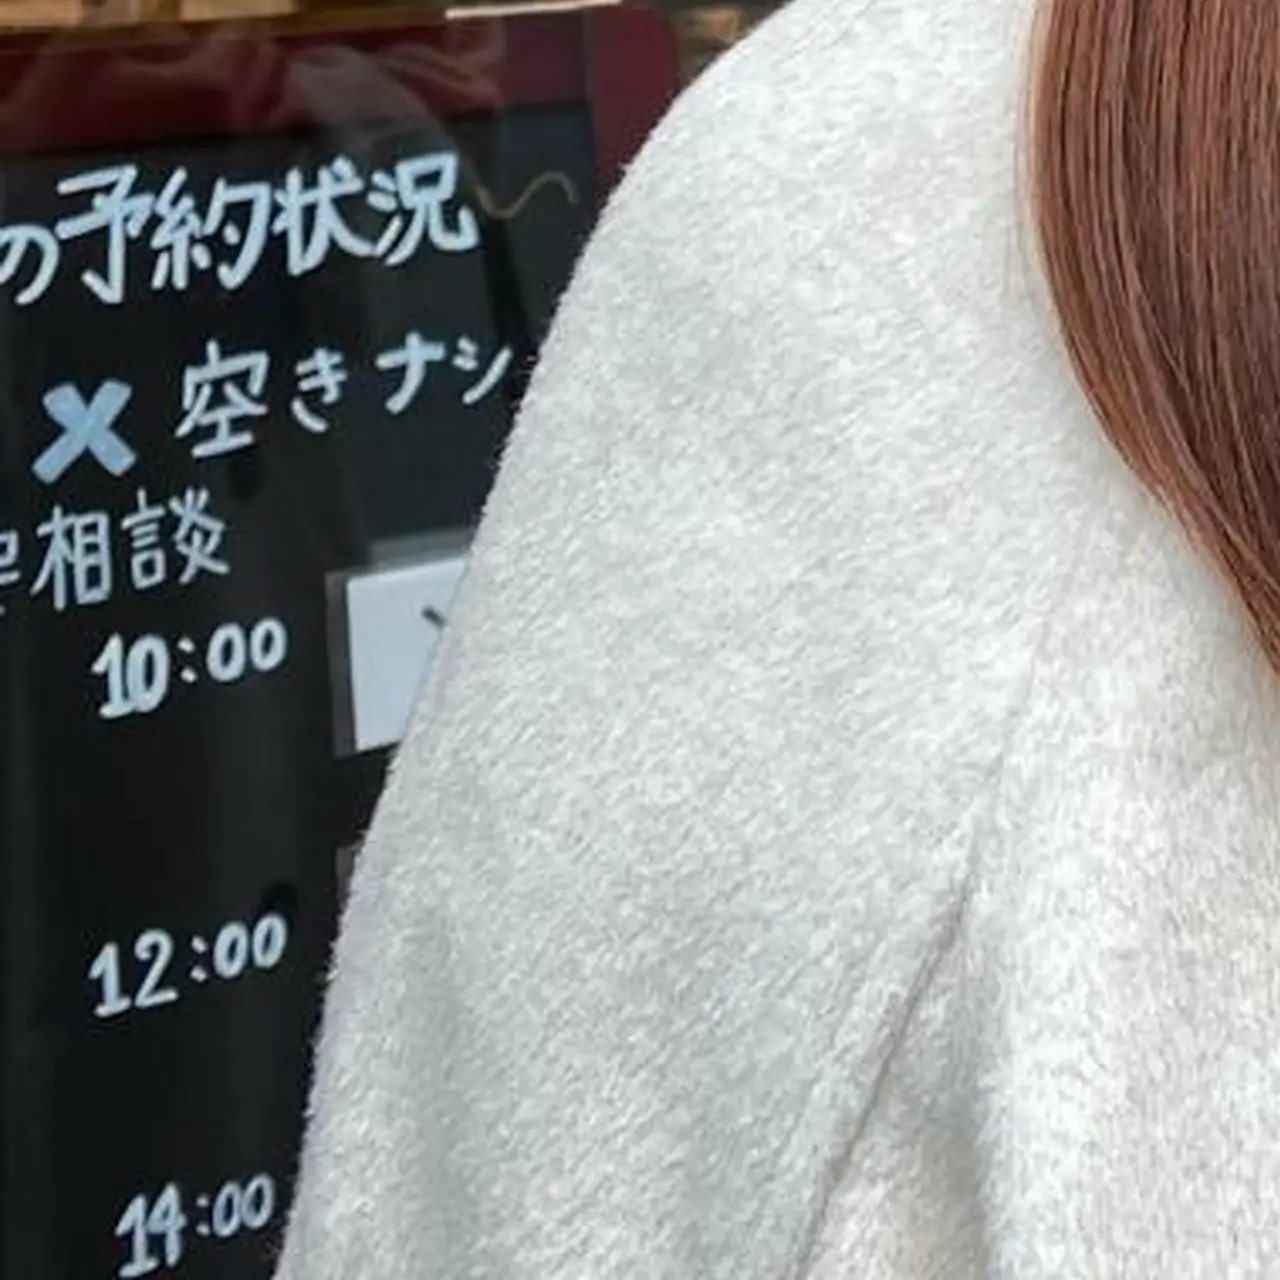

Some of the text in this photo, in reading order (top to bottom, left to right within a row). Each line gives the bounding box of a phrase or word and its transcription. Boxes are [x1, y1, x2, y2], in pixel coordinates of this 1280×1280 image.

[0, 152, 478, 304] の予約状況
[176, 332, 512, 458] 空きナシ
[92, 618, 287, 719] 10:00
[90, 914, 287, 1018] 12:00
[115, 1175, 275, 1278] 14:00
